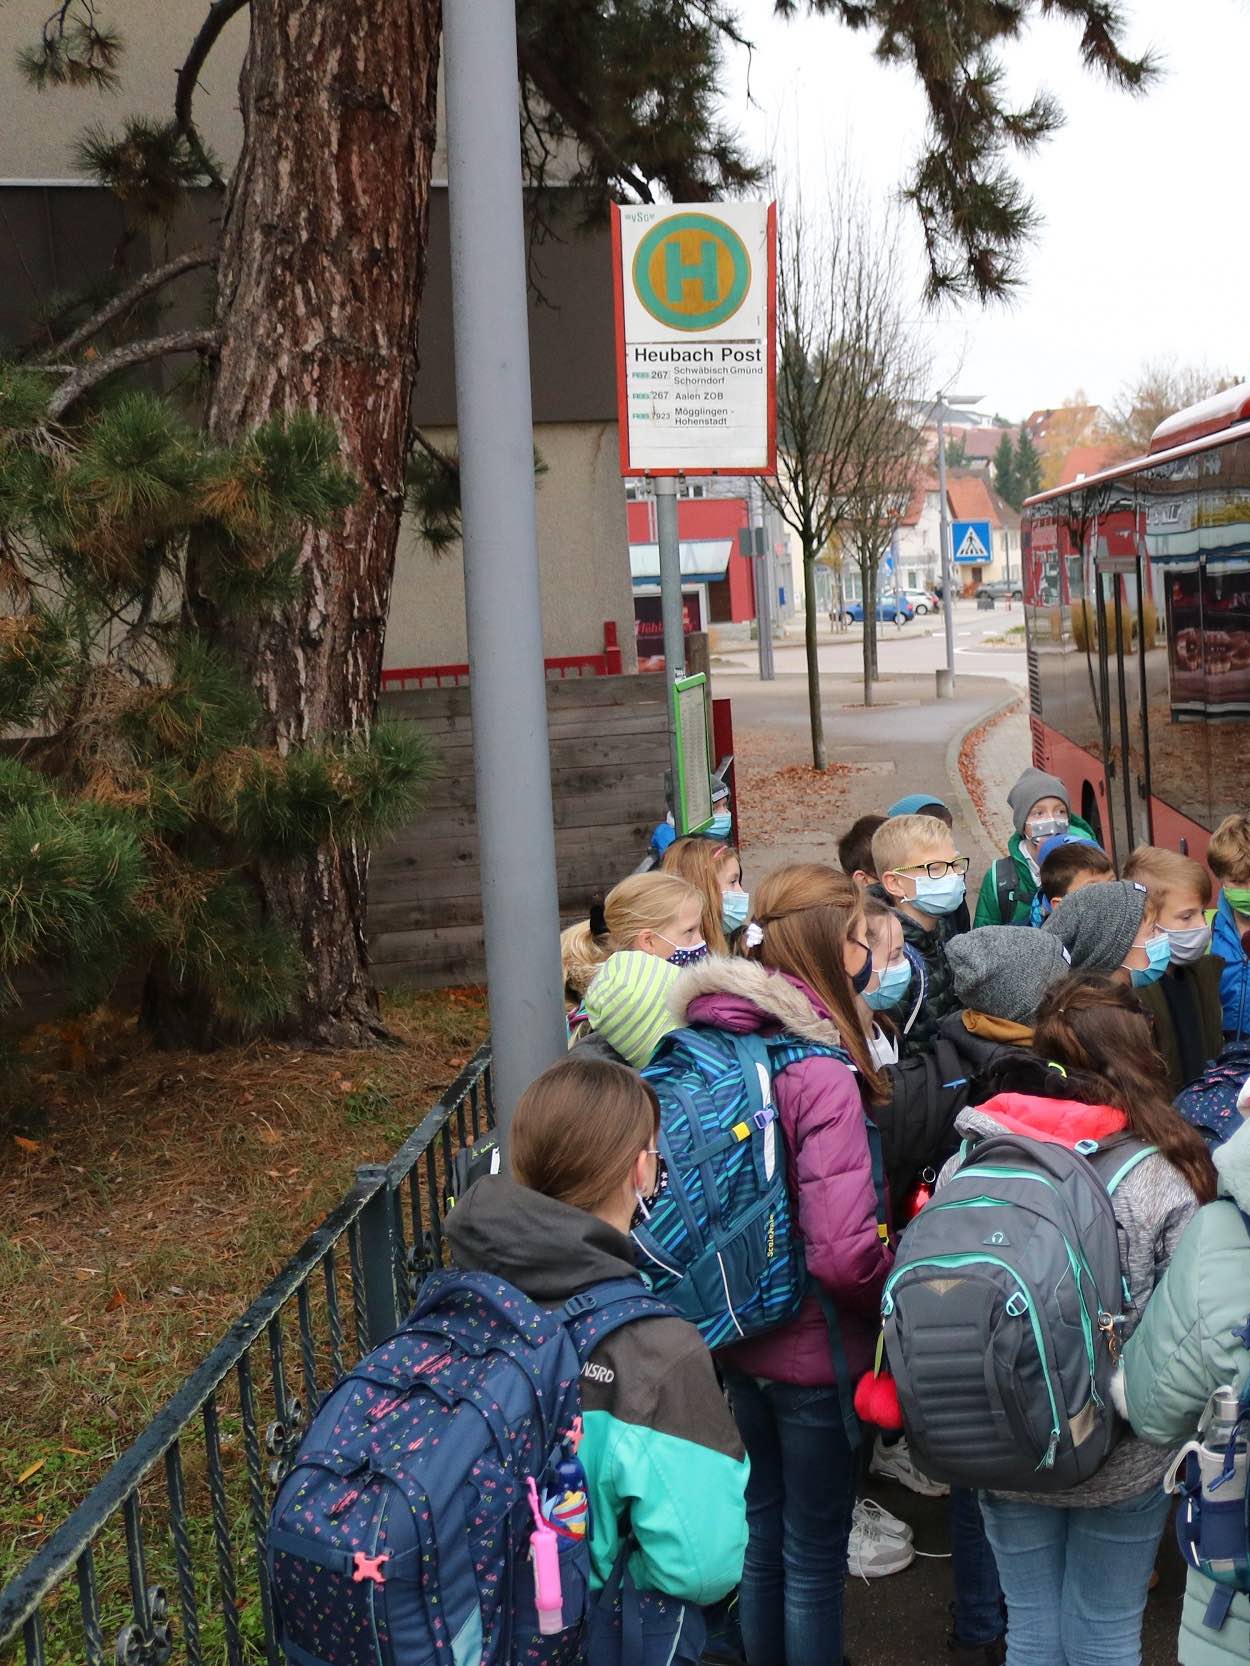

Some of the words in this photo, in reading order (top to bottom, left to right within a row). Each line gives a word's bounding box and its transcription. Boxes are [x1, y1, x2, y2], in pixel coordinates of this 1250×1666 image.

[665, 241, 718, 302] H
[635, 347, 713, 362] Heubach
[721, 347, 761, 361] Post
[651, 371, 668, 379] 267
[674, 366, 728, 375] Schwäbisch
[730, 366, 763, 374] Gmünd
[674, 377, 725, 385] Schorndorf
[675, 392, 700, 400] Aalen
[704, 392, 724, 400] ZOB
[675, 407, 728, 417] Mögglingen
[675, 417, 727, 425] Hohenstadt
